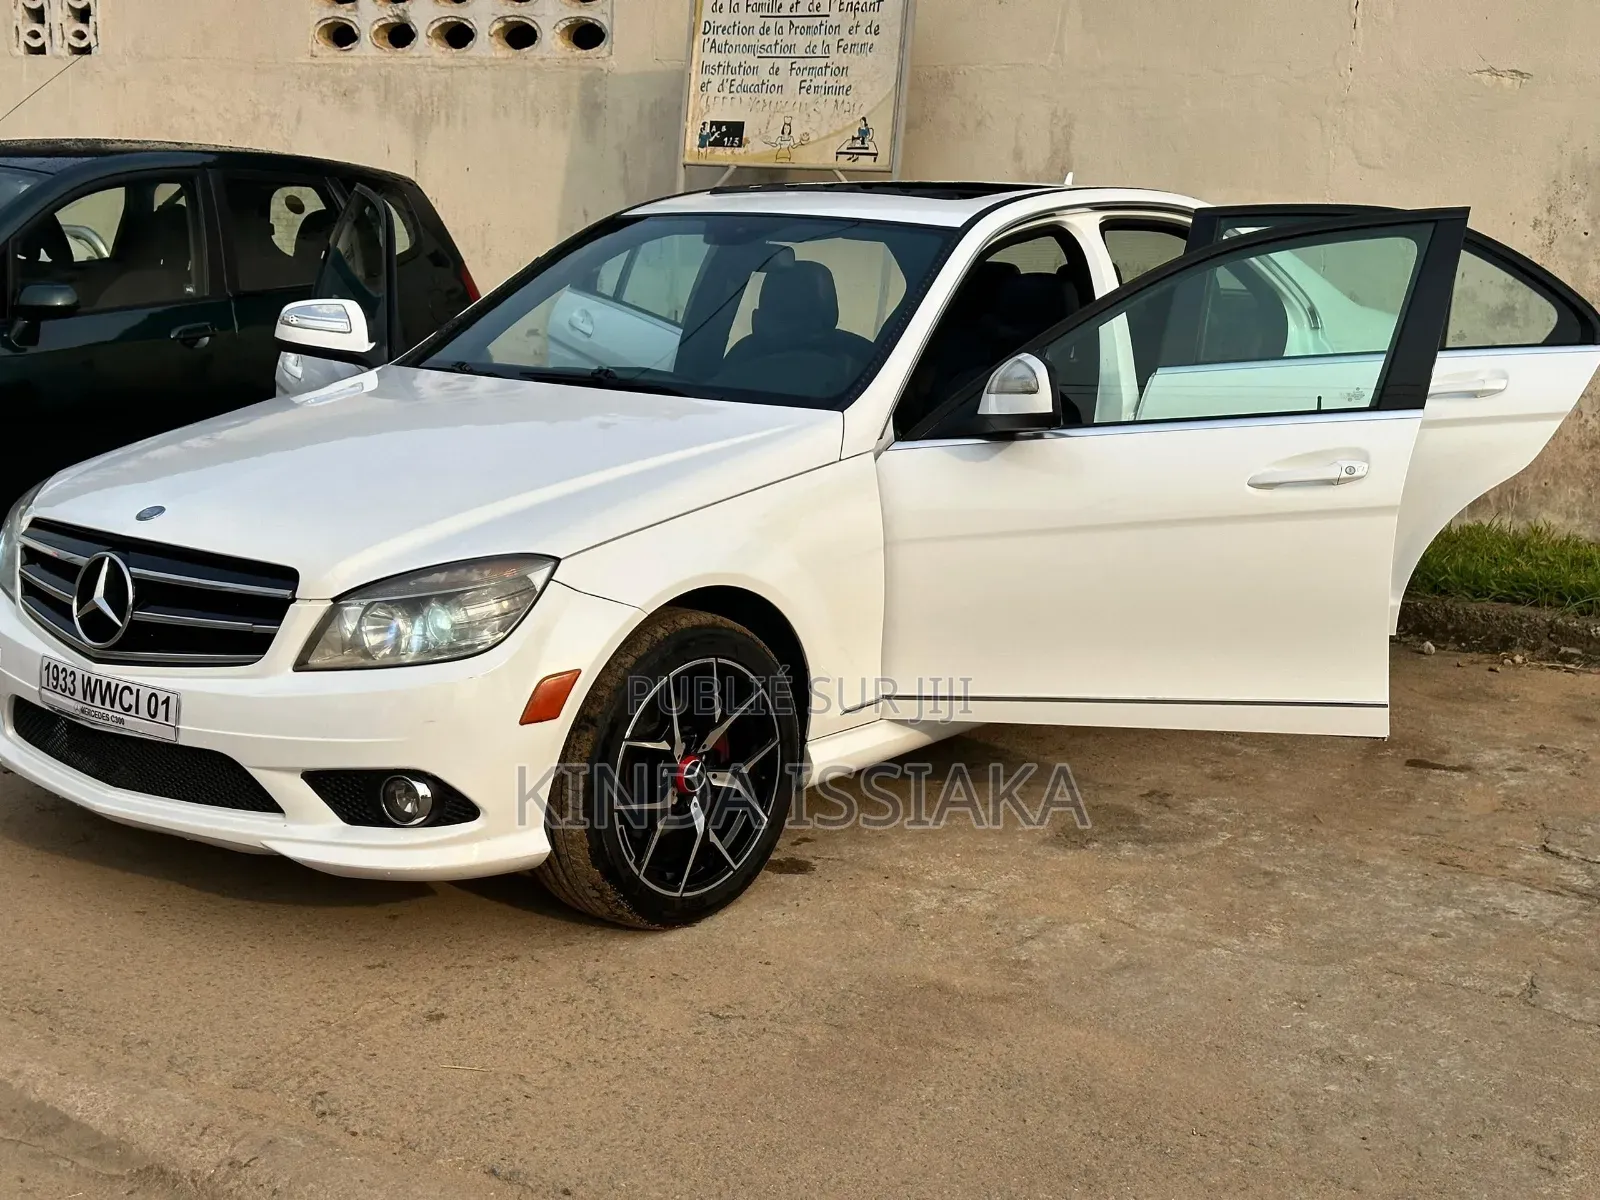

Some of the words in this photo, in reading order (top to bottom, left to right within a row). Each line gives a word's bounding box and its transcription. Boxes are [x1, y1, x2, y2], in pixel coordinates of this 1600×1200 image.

[711, 0, 723, 13] de
[728, 0, 740, 13] la
[745, 0, 783, 13] Famille
[789, 0, 801, 13] et
[807, 0, 821, 13] de
[702, 20, 755, 36] Direction
[758, 21, 771, 36] de
[774, 21, 784, 36] la
[788, 20, 840, 37] Promotion
[848, 21, 861, 36] et
[864, 20, 880, 36] de
[702, 38, 796, 57] l'Autonomisation
[804, 41, 818, 54] de
[821, 40, 831, 55] la
[836, 38, 874, 57] Femme
[701, 60, 759, 76] Institution
[768, 62, 780, 76] de
[789, 61, 849, 78] Formation
[700, 78, 712, 93] et
[717, 78, 783, 95] d'Education
[799, 79, 852, 96] Féminine
[44, 661, 77, 697] 1933
[81, 673, 141, 716] WWCI
[147, 691, 171, 723] 01
[80, 707, 111, 722] MERCEDES
